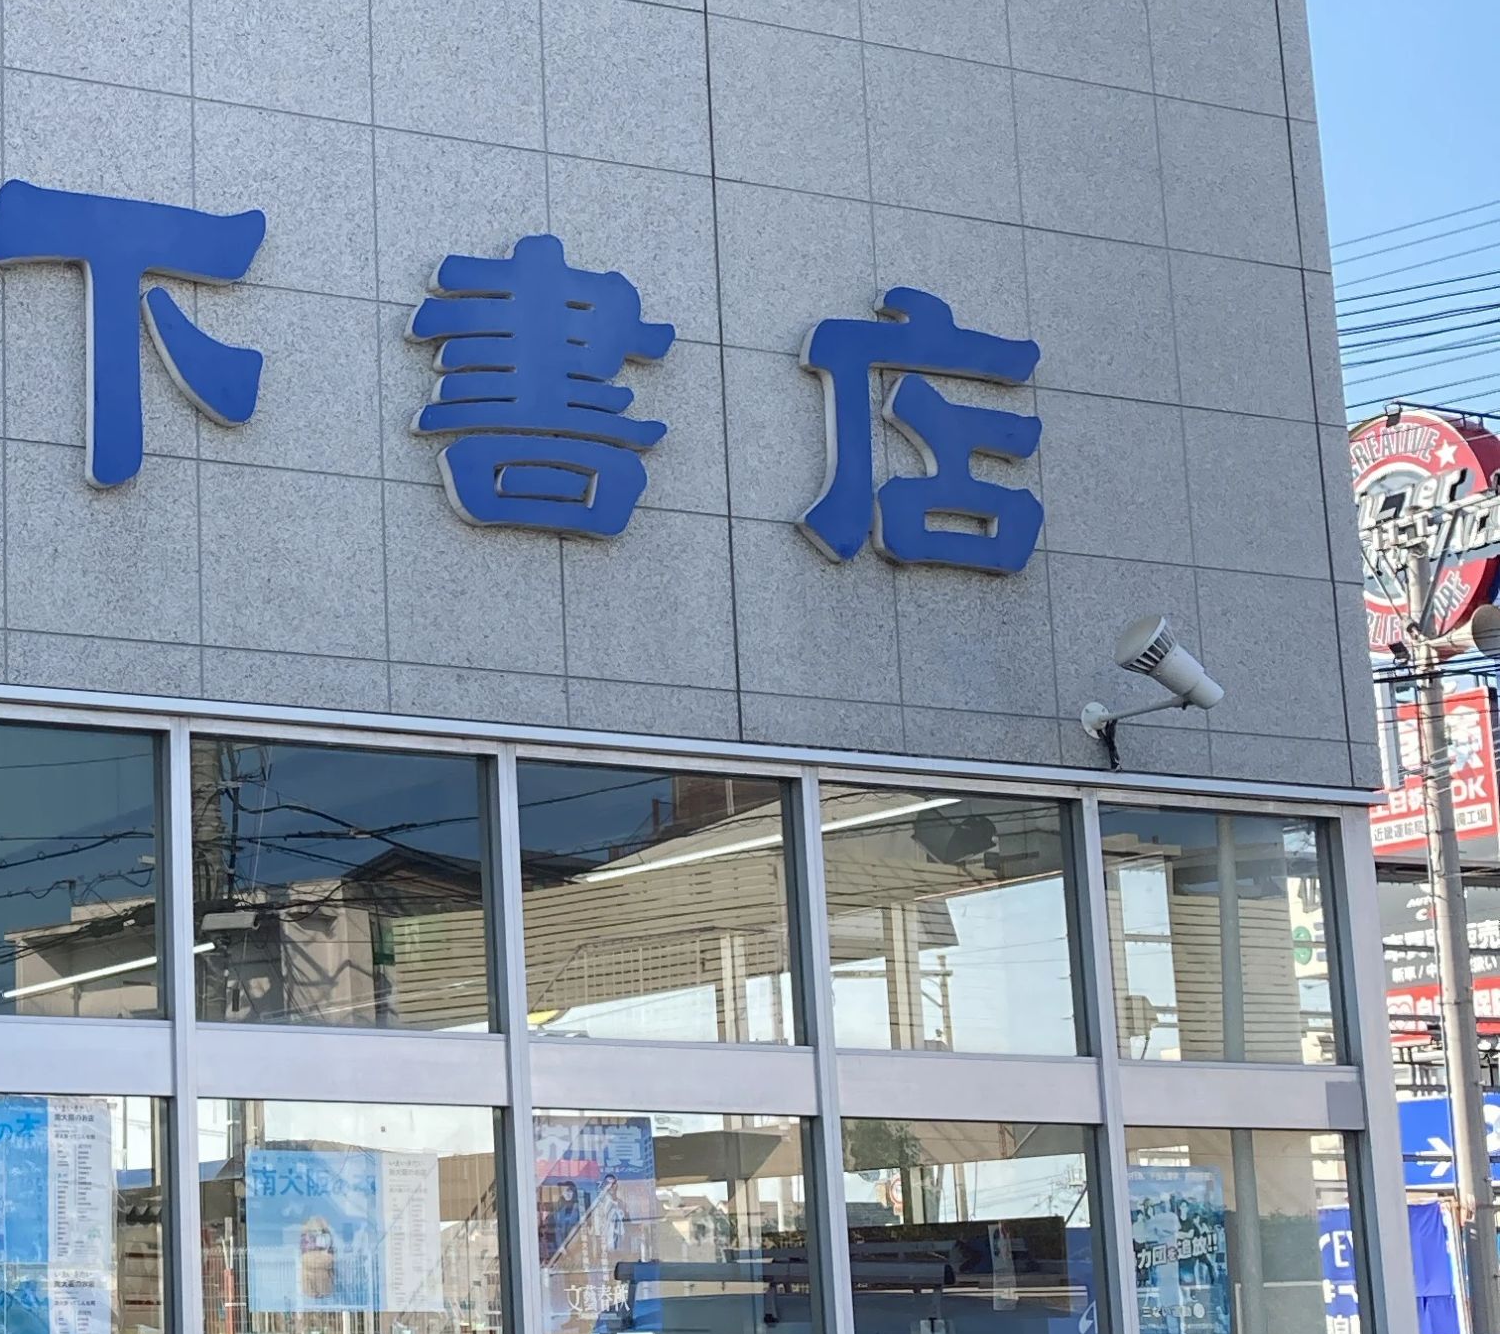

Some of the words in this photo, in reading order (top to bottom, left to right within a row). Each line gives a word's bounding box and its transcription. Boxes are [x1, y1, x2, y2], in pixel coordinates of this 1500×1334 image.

[1136, 1233, 1218, 1269] 力団を追放!!
